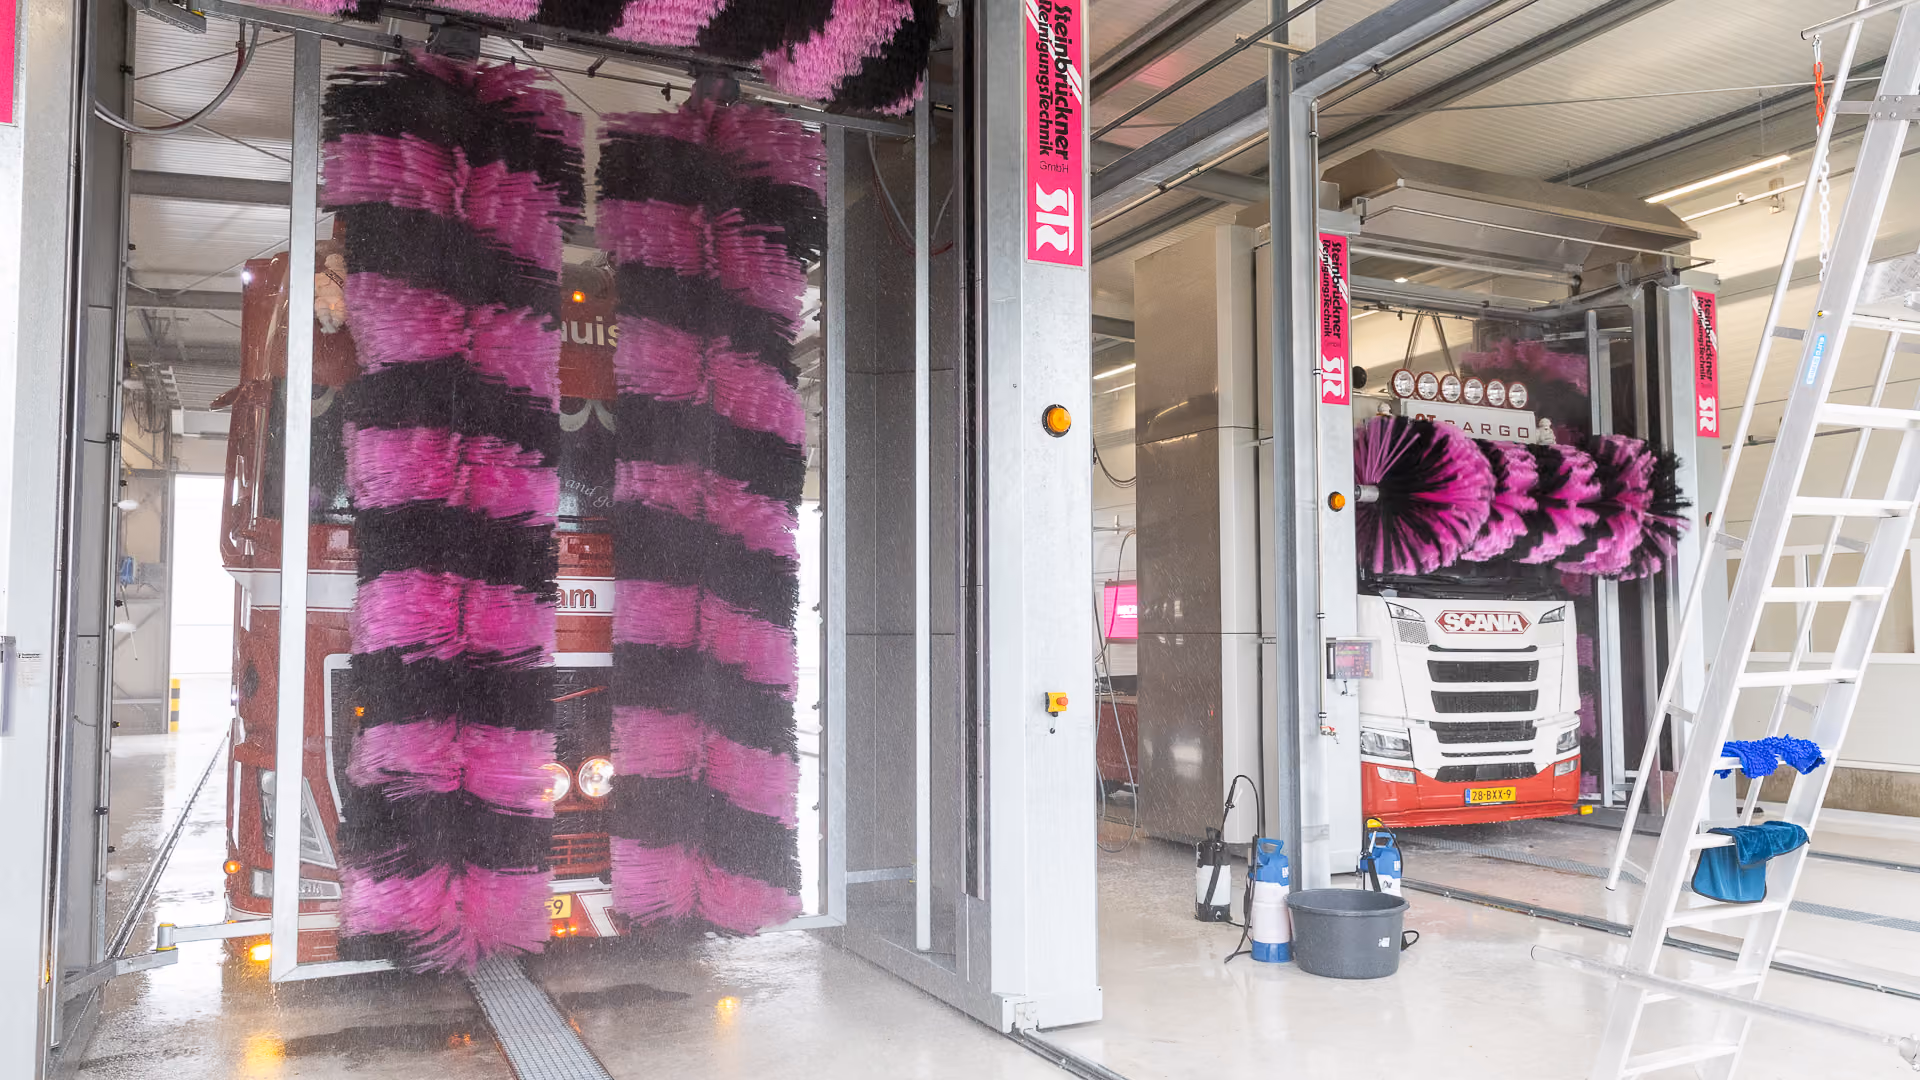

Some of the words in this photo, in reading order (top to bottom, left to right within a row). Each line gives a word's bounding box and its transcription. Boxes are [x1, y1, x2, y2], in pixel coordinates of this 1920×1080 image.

[1054, 2, 1073, 160] Steinbrückner
[1040, 161, 1069, 174] GmbH
[1331, 241, 1343, 339] Steinbrückner
[1444, 419, 1529, 439] ARGO
[1443, 612, 1523, 632] SCANIA
[1472, 789, 1512, 801] 28-BXX-9
